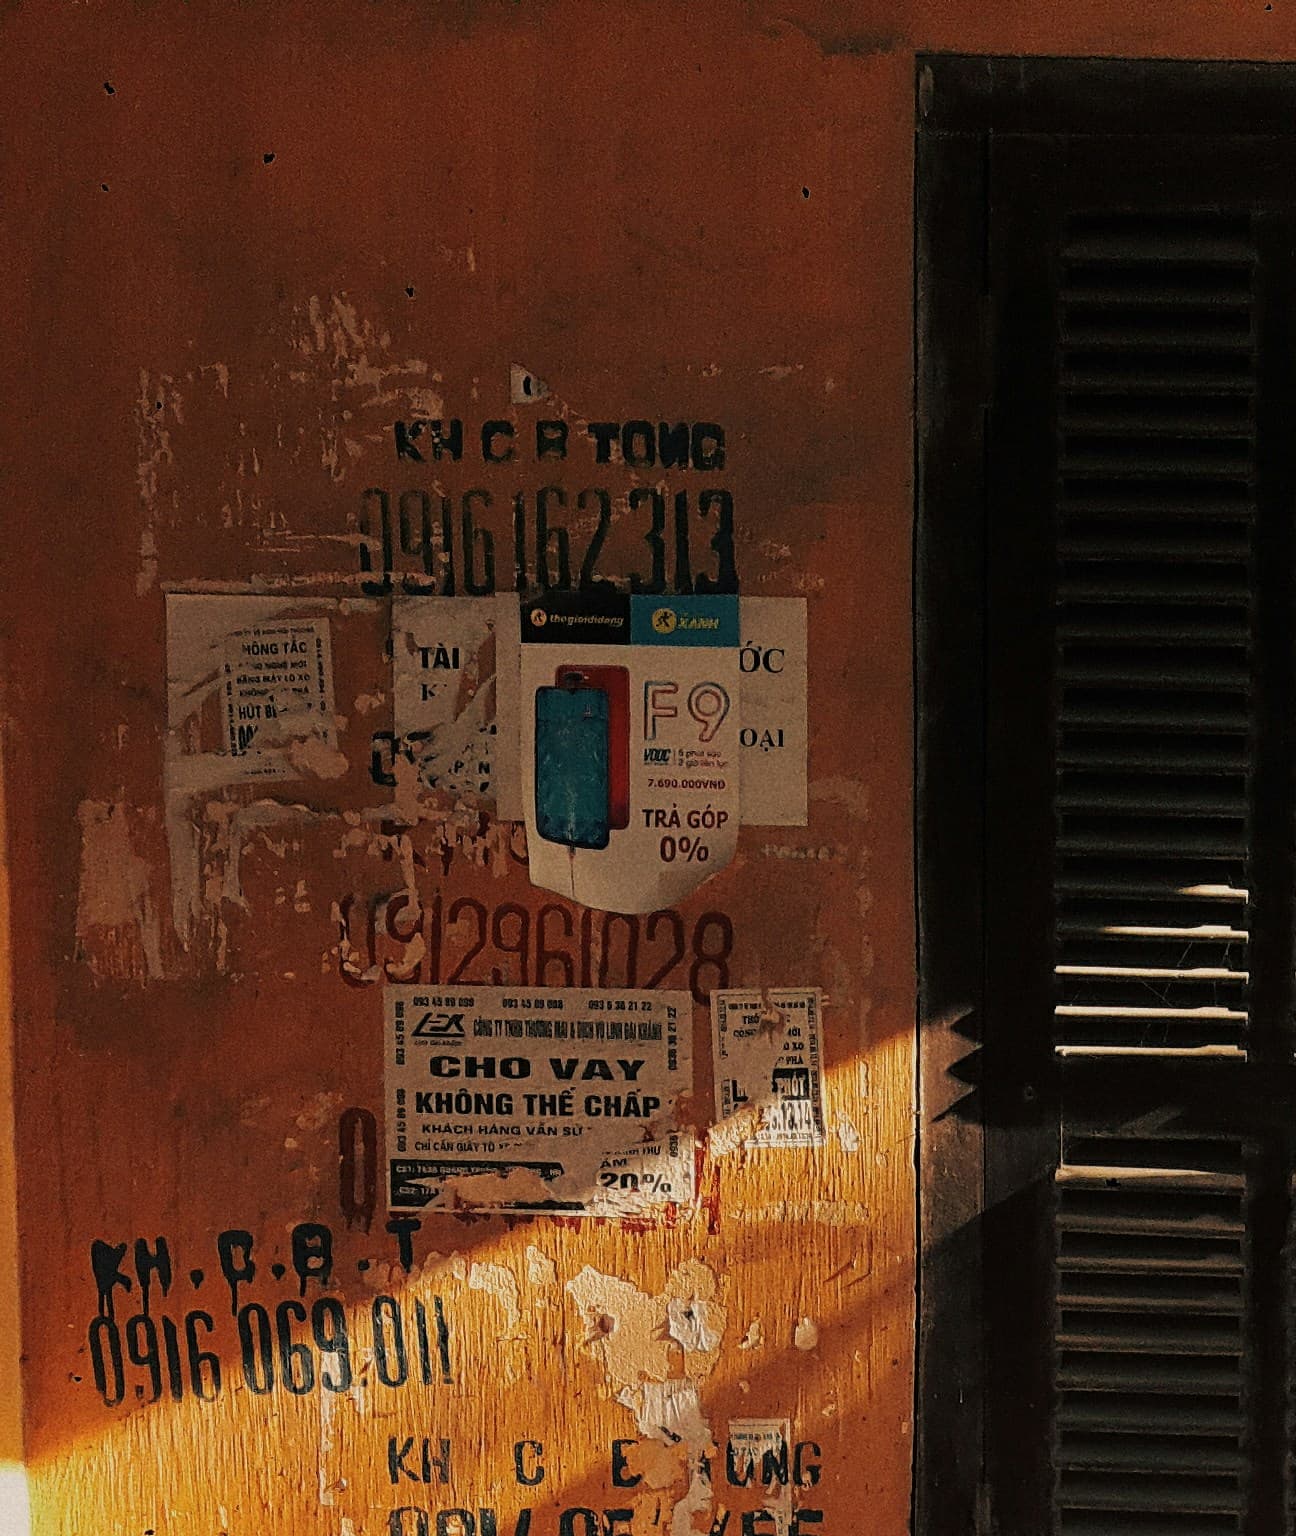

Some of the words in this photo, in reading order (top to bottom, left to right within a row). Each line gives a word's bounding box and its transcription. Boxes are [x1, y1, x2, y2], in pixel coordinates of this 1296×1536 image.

[642, 803, 681, 829] TRẢ
[687, 805, 729, 829] GÓP
[660, 836, 709, 863] 0%
[429, 1056, 531, 1079] CHO
[549, 1058, 646, 1081] VAY
[415, 1088, 513, 1115] KHÔNG
[523, 1086, 576, 1116] THẾ
[584, 1088, 661, 1117] CHẤP
